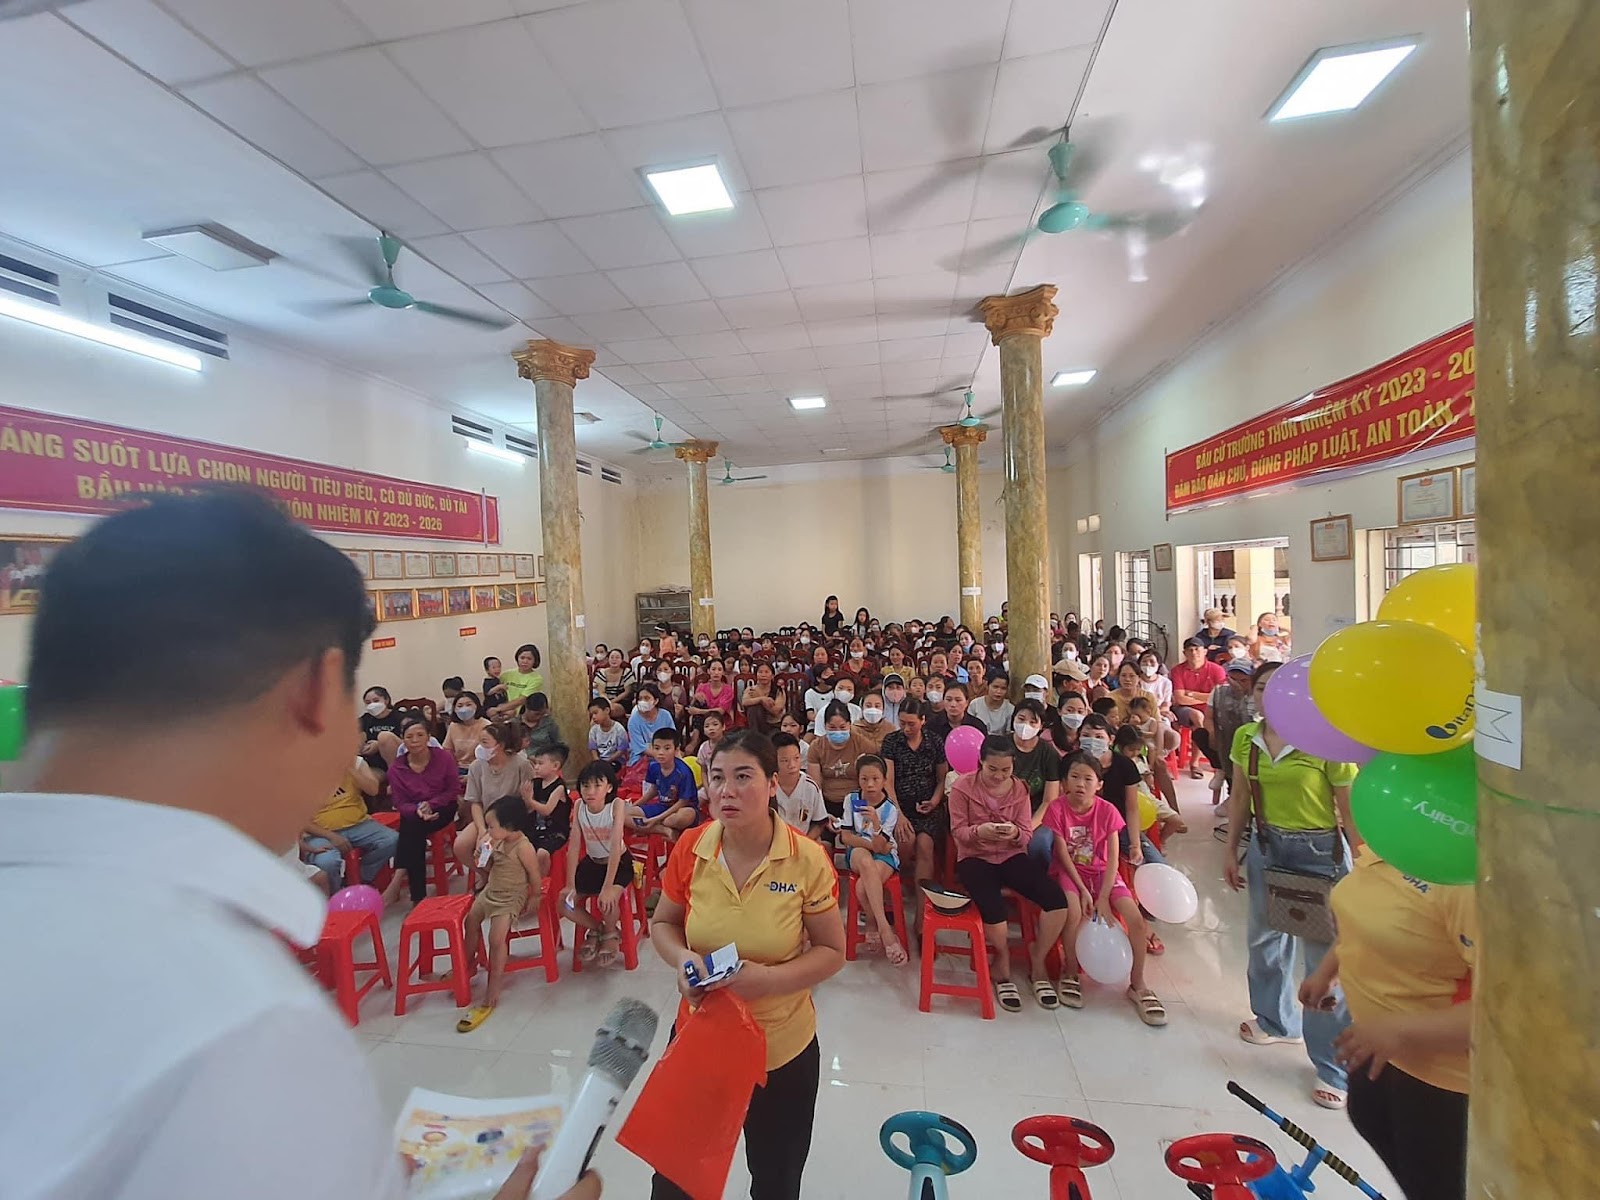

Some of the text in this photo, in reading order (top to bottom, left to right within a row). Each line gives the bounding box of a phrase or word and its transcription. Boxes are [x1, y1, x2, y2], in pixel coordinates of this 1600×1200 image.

[1376, 367, 1426, 406] 2023
[1283, 440, 1319, 470] PHÁP
[1322, 428, 1361, 459] LUẬT,
[1366, 418, 1393, 448] AN
[72, 437, 141, 469] SUỐT
[148, 449, 193, 478] LỰA
[256, 467, 307, 492] NGƯỜI
[310, 475, 341, 497] TIÊU
[344, 478, 377, 503] BIỂU,
[380, 486, 395, 505] CÓ
[317, 503, 361, 526] NHIỆM
[364, 506, 381, 526] KỲ
[383, 511, 410, 529] 2023
[419, 515, 443, 531] 2026
